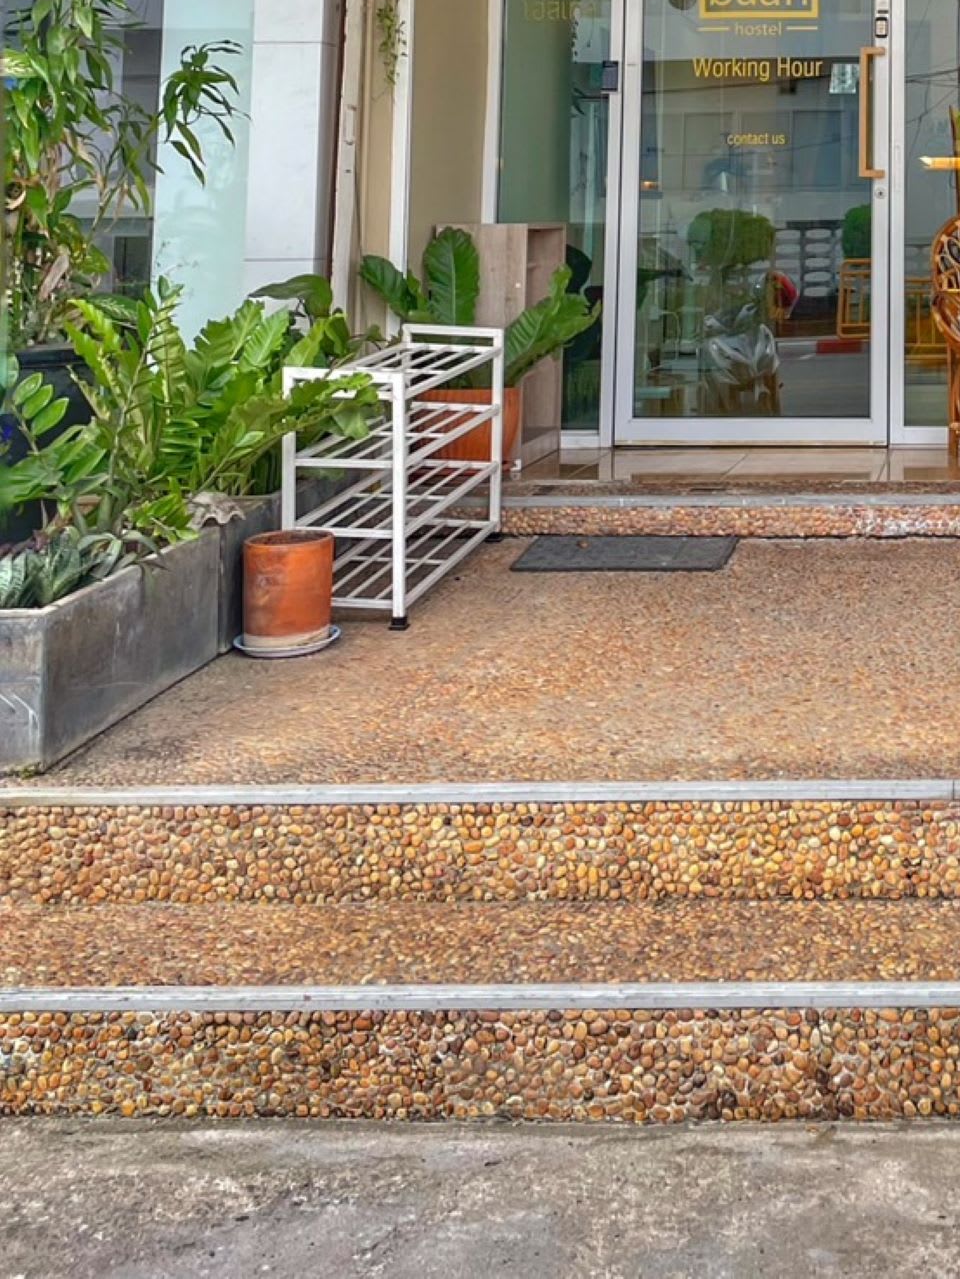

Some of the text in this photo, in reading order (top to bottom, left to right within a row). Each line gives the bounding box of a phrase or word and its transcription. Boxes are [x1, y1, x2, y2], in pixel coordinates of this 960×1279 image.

[735, 22, 782, 36] hostel
[693, 57, 824, 81] Working Hour
[727, 132, 786, 146] contact us
